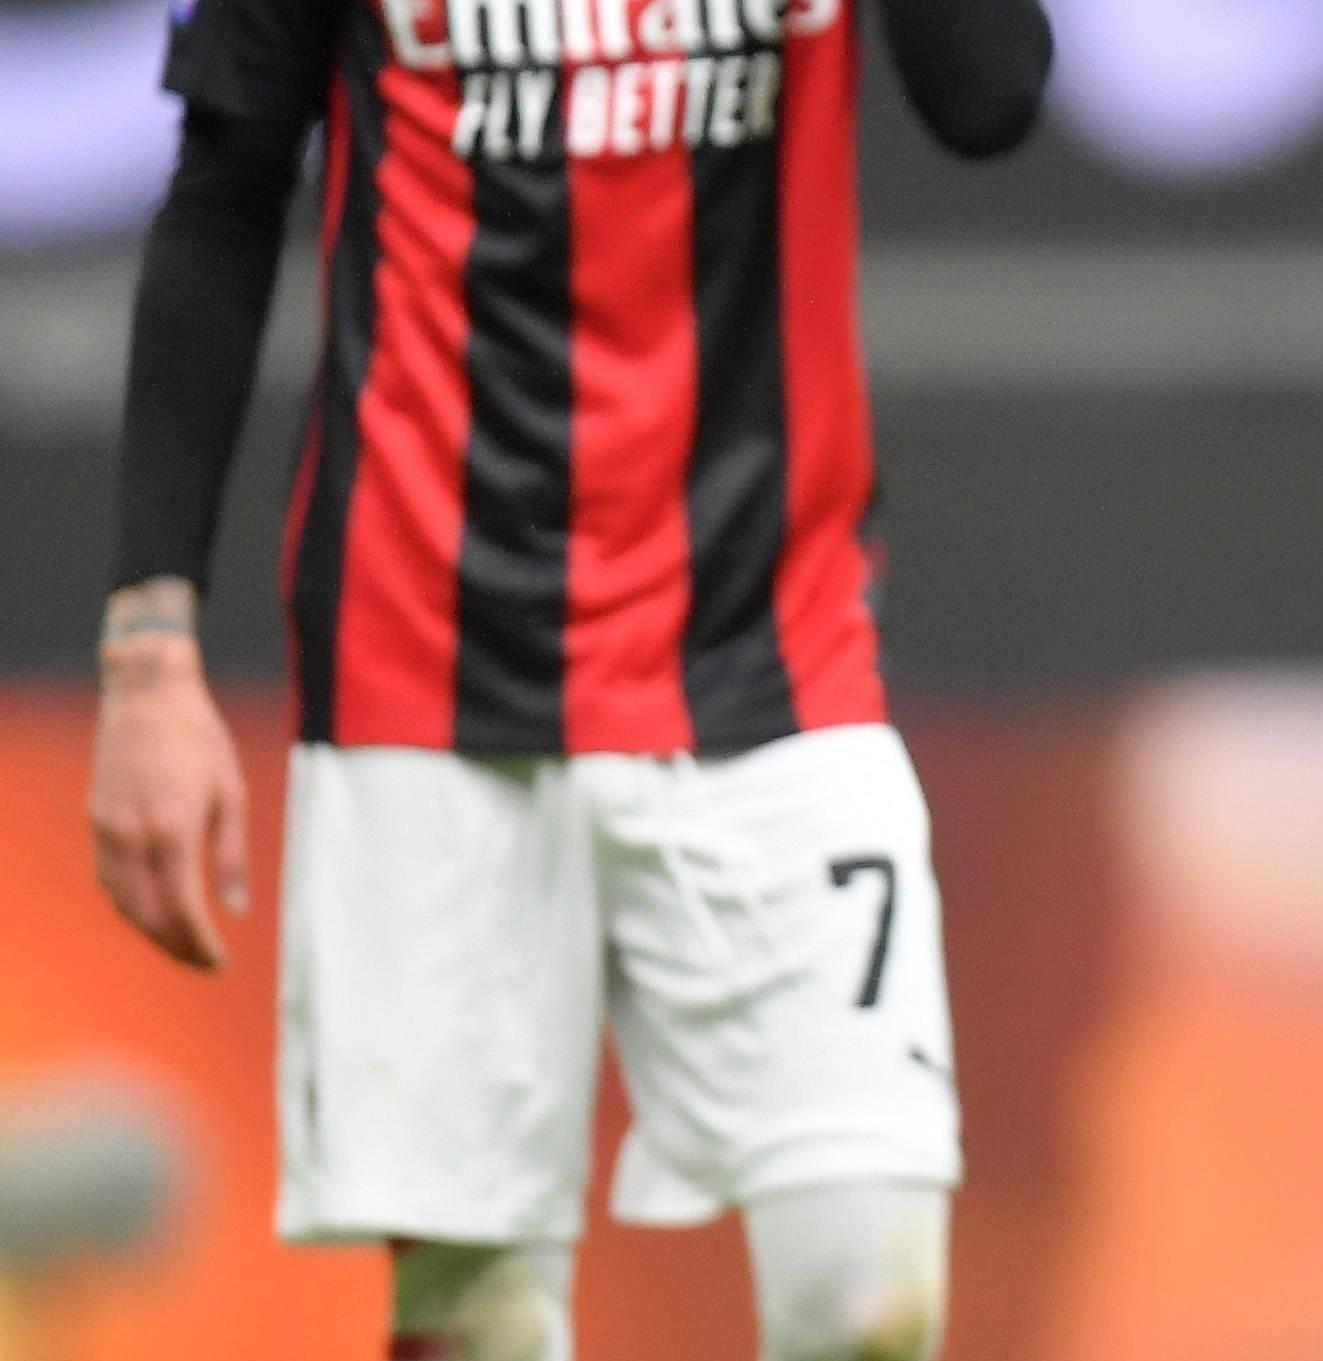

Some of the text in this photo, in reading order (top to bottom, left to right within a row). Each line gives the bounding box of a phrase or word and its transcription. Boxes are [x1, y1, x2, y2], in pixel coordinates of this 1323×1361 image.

[453, 53, 780, 157] FLY BETTER
[829, 856, 896, 1009] 7
